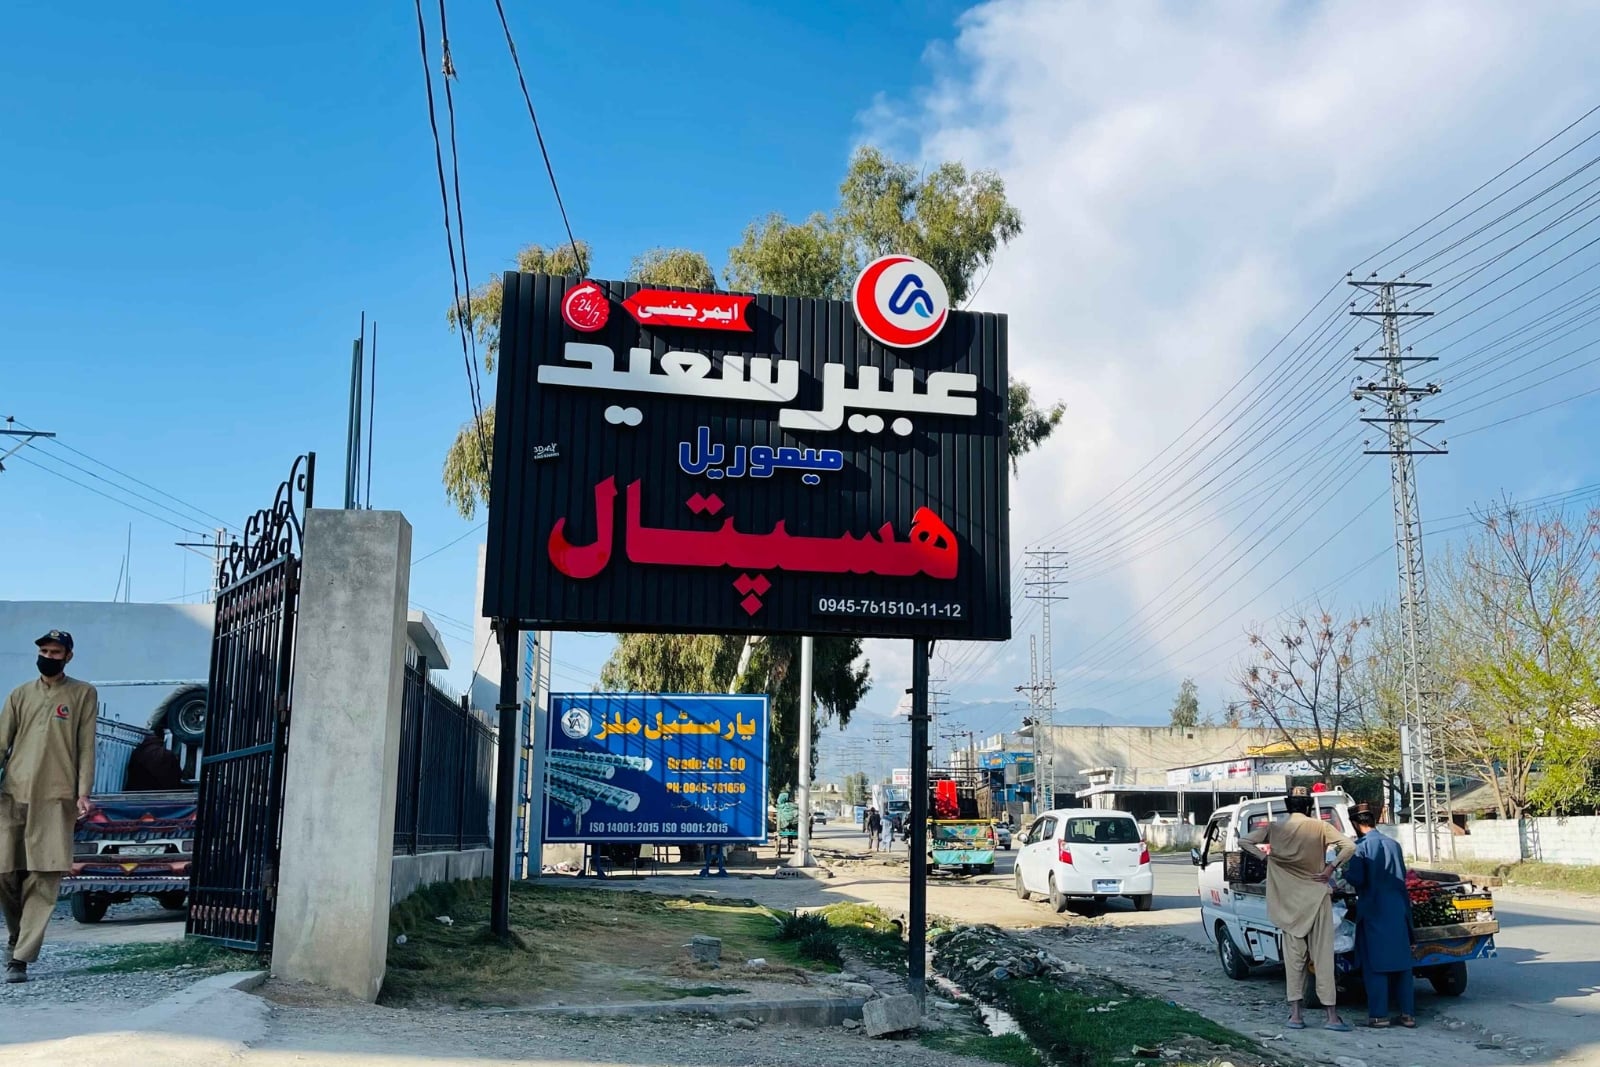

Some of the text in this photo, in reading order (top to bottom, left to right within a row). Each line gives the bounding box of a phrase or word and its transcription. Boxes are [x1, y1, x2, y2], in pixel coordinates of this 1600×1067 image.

[577, 298, 600, 323] 24/7
[636, 301, 739, 323] ایمرجنسی
[537, 341, 978, 437] عبیر سعید
[678, 426, 844, 486] میموریل
[818, 597, 962, 618] 0945-761510-11-12
[593, 709, 756, 741] یار سٹیل ملز
[729, 757, 746, 771] 60
[589, 822, 729, 834] ISO 14001:2015 ISO 9001:2015
